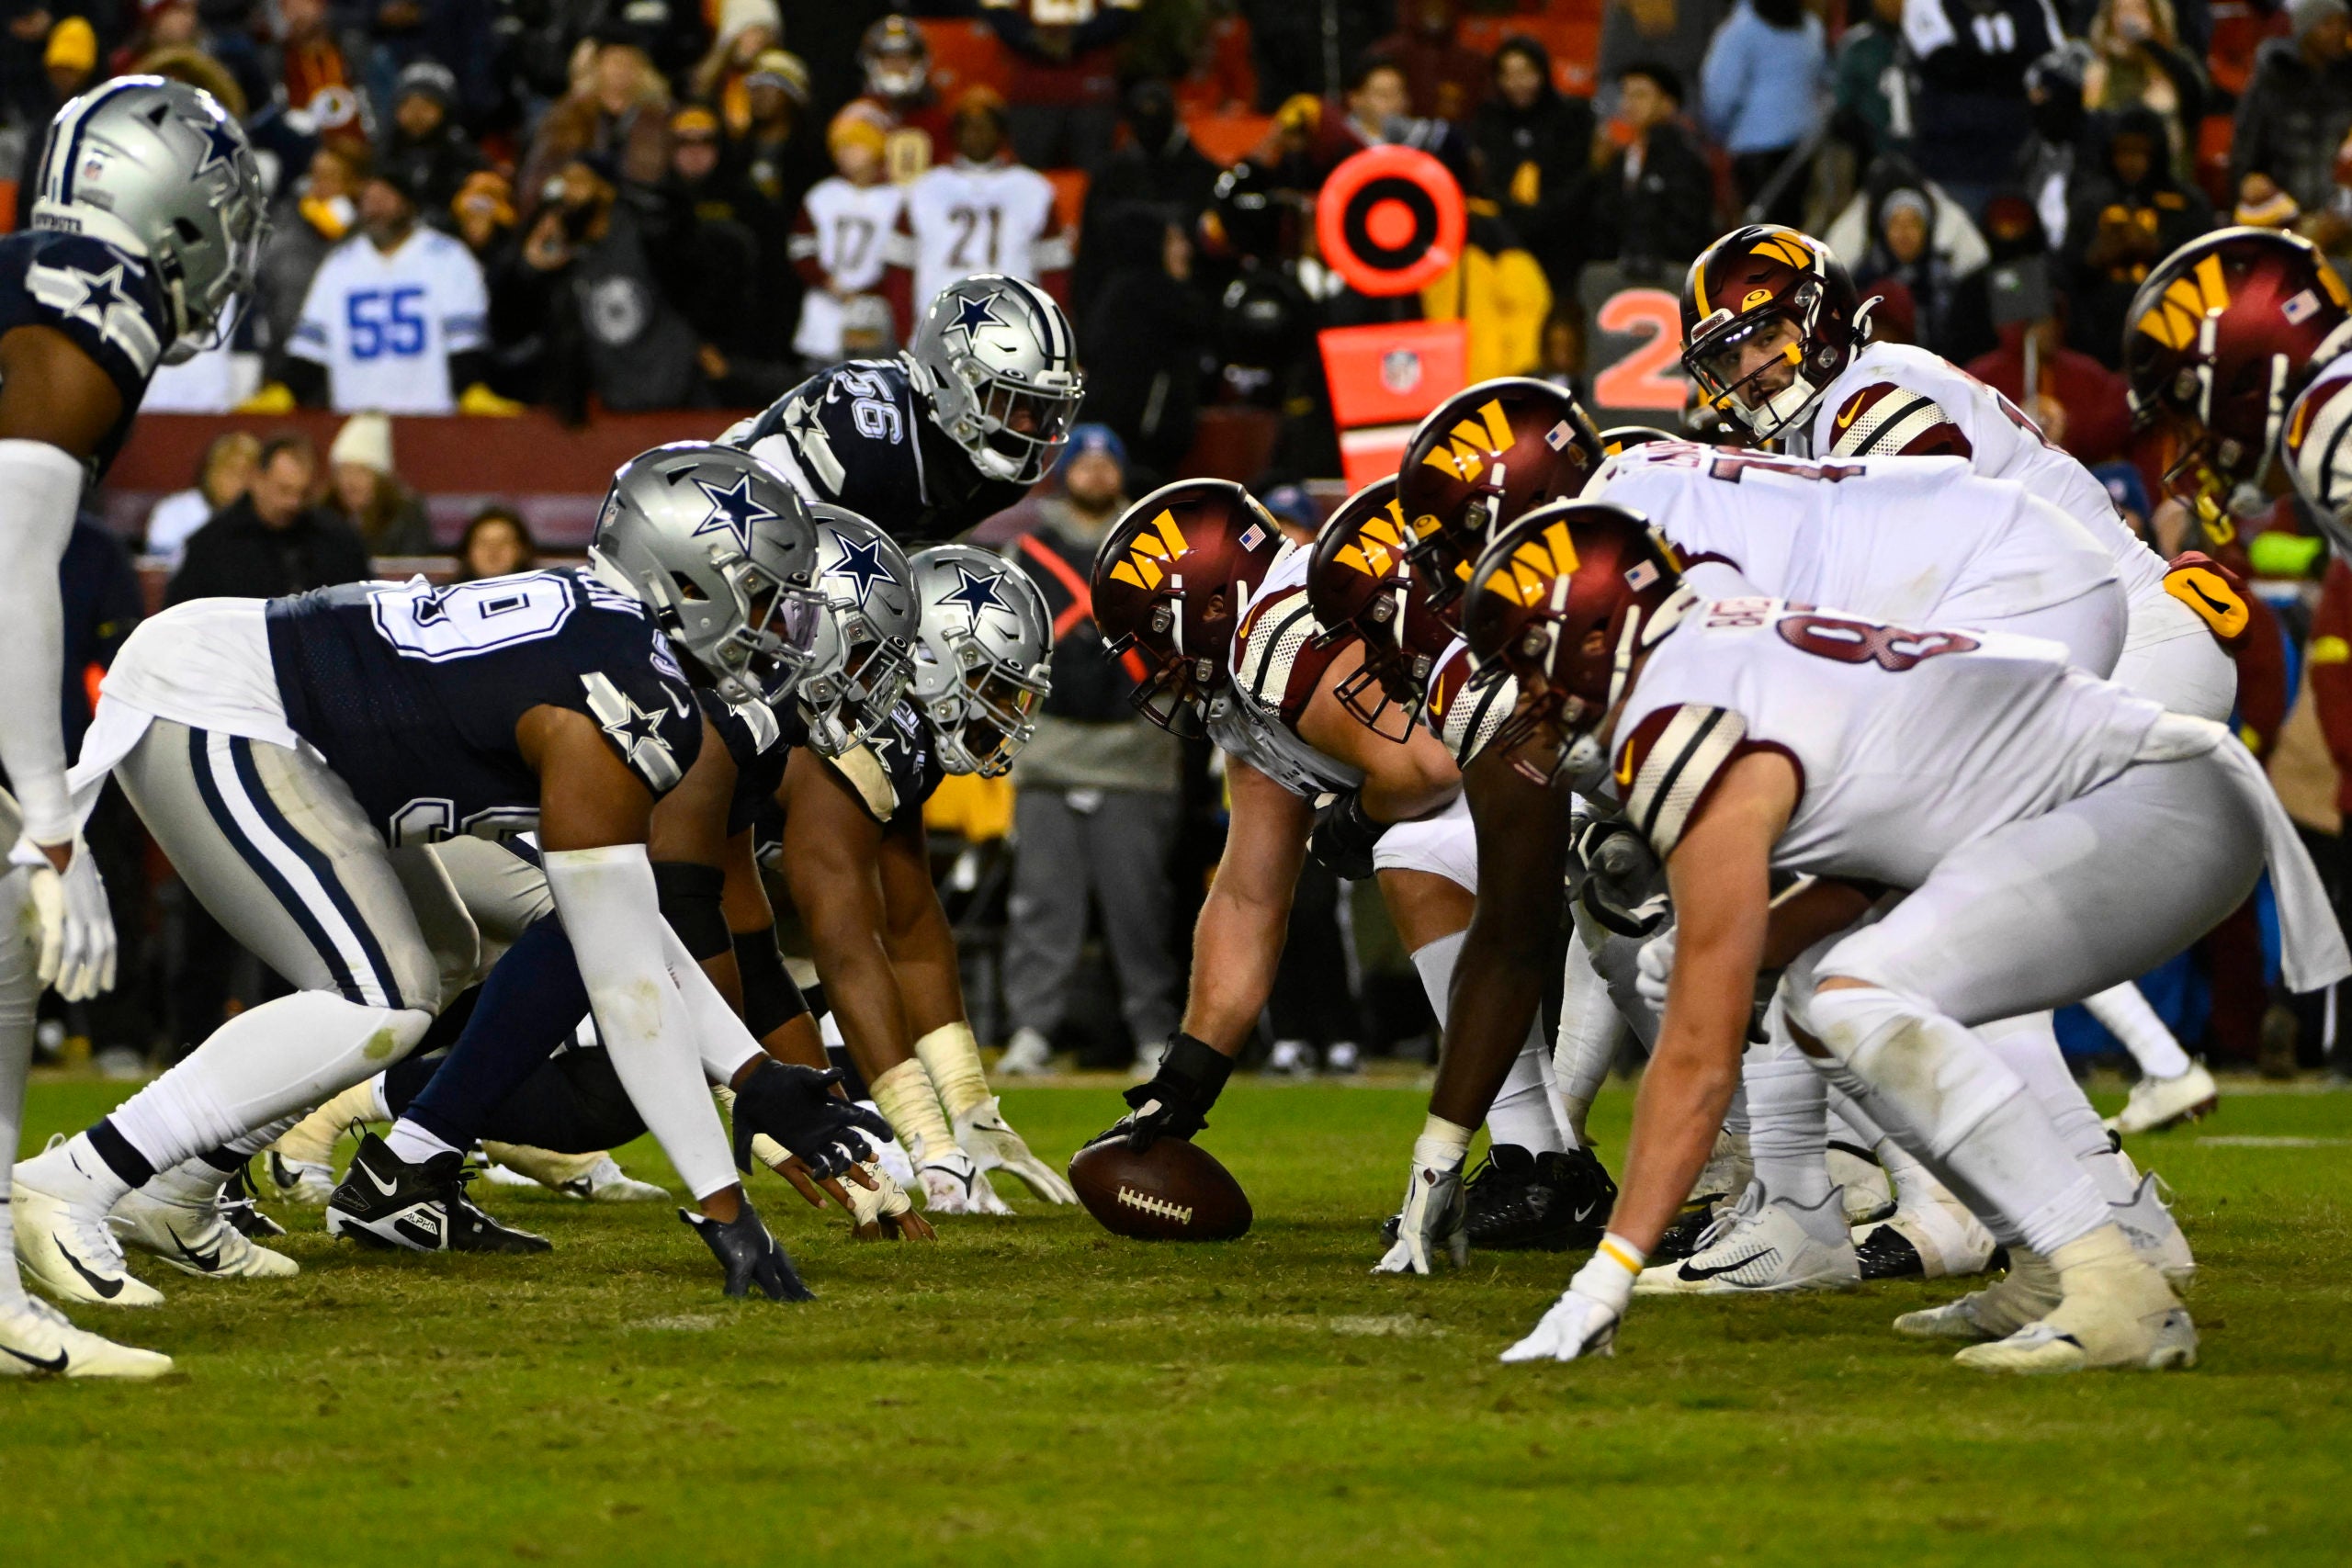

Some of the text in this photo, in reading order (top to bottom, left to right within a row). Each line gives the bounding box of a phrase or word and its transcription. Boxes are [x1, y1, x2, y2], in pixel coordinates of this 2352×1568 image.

[835, 215, 875, 271] 17
[947, 204, 1002, 269] 21
[346, 286, 427, 360] 55
[1594, 288, 1689, 408] 2
[832, 370, 903, 446] 56
[404, 1213, 437, 1234] ALPHA
